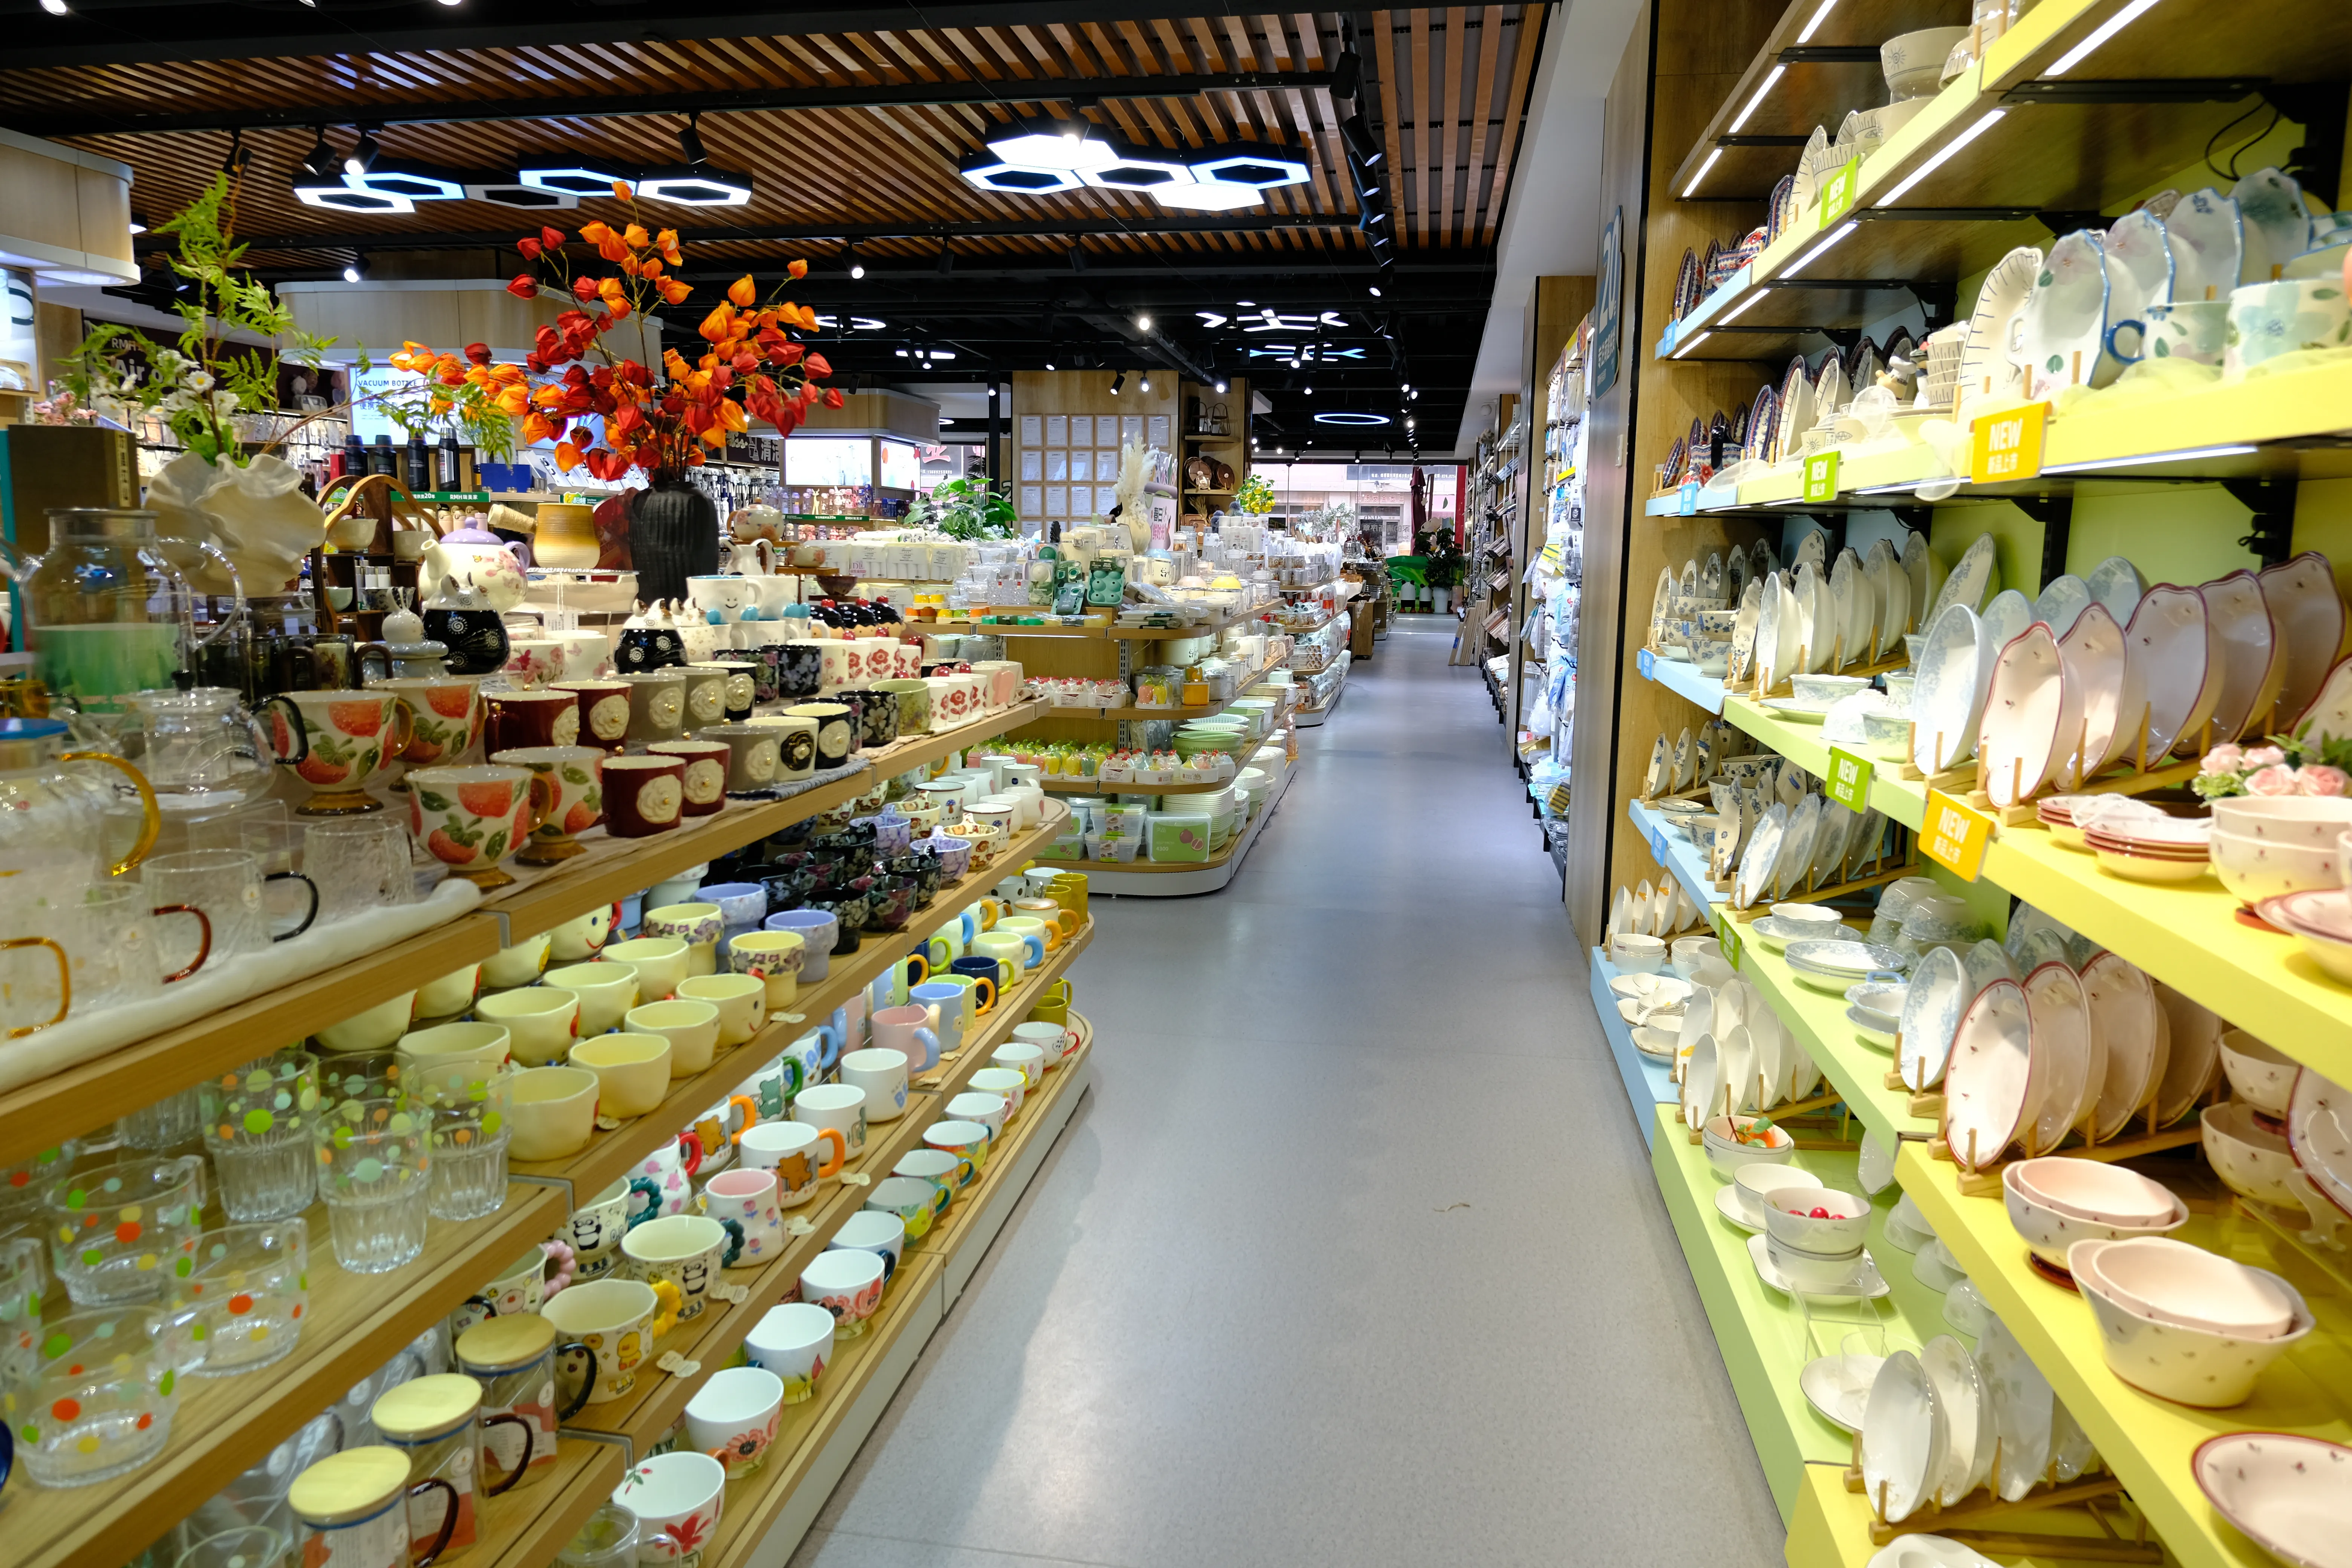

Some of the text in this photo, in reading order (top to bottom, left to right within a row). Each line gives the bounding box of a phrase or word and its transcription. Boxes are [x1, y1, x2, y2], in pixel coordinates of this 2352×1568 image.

[1828, 171, 1847, 204] NEW
[1599, 215, 1619, 334] 20
[1988, 417, 2024, 452] NEW
[1811, 460, 1828, 481] NEW
[1987, 452, 2018, 475] 新品上市
[1837, 758, 1859, 786] NEW
[1937, 806, 1971, 844] NEW
[1933, 835, 1962, 864] 新品上市
[1724, 925, 1735, 954] NEW
